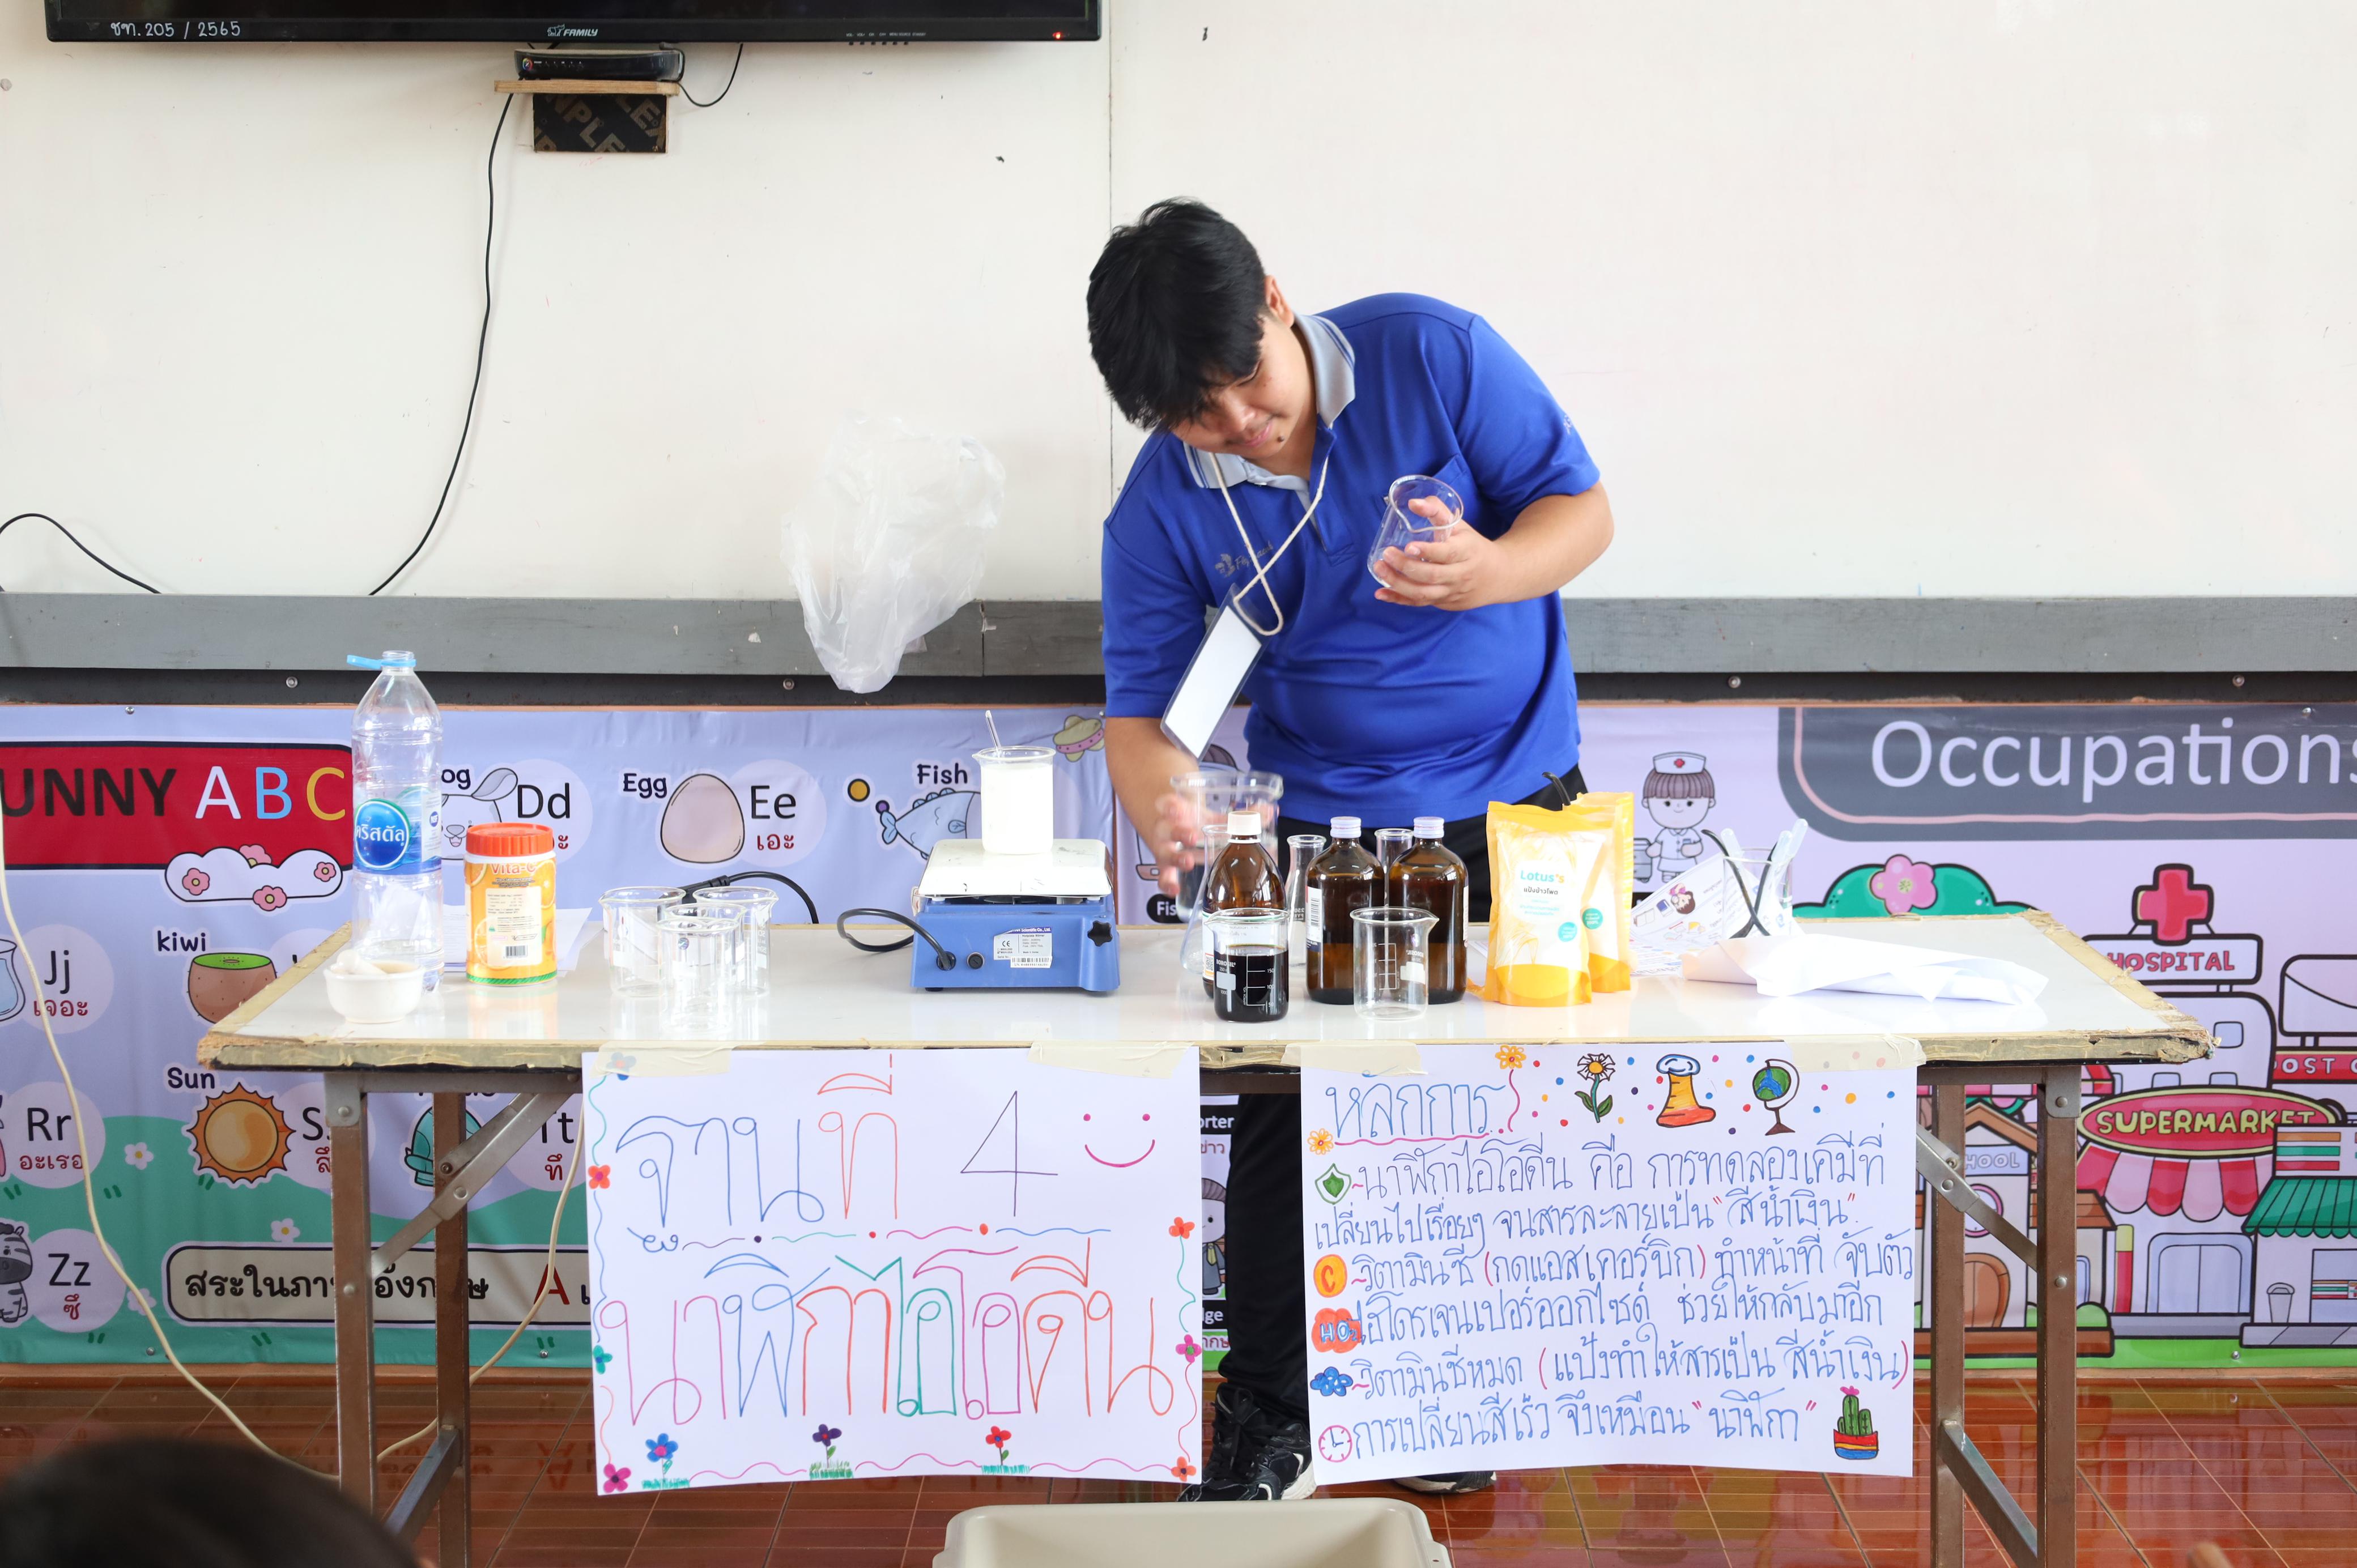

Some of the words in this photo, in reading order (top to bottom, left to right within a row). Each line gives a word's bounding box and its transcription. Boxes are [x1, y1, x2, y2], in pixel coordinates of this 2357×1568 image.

[145, 22, 175, 37] 205
[198, 21, 241, 37] 2565
[563, 28, 598, 37] FAMILY
[441, 769, 471, 790] og
[917, 762, 968, 785] Fish
[623, 773, 667, 799] Egg
[517, 783, 571, 819] Dd
[750, 785, 797, 820] Ee
[757, 833, 795, 851] เอะ
[491, 863, 536, 875] Vita-C
[1524, 886, 1558, 895] แป้งข้าวโพด
[156, 930, 206, 952] kiwi
[44, 949, 70, 995] Jj
[2107, 950, 2235, 973] HOSPITAL
[33, 999, 88, 1017] เจอะ
[2274, 1057, 2335, 1075] OST
[167, 1067, 215, 1089] Sun
[26, 1107, 72, 1142] Rr
[302, 1106, 330, 1141] S
[2096, 1109, 2316, 1135] SUPERMARKET
[615, 1054, 897, 1252] ฐานที่
[960, 1090, 1058, 1217] 4
[1581, 1133, 1633, 1190] คือ
[1965, 1152, 2020, 1169] HOOL
[1834, 1226, 1913, 1280] จับตัว
[48, 1252, 92, 1286] Zz
[533, 1263, 570, 1305] A
